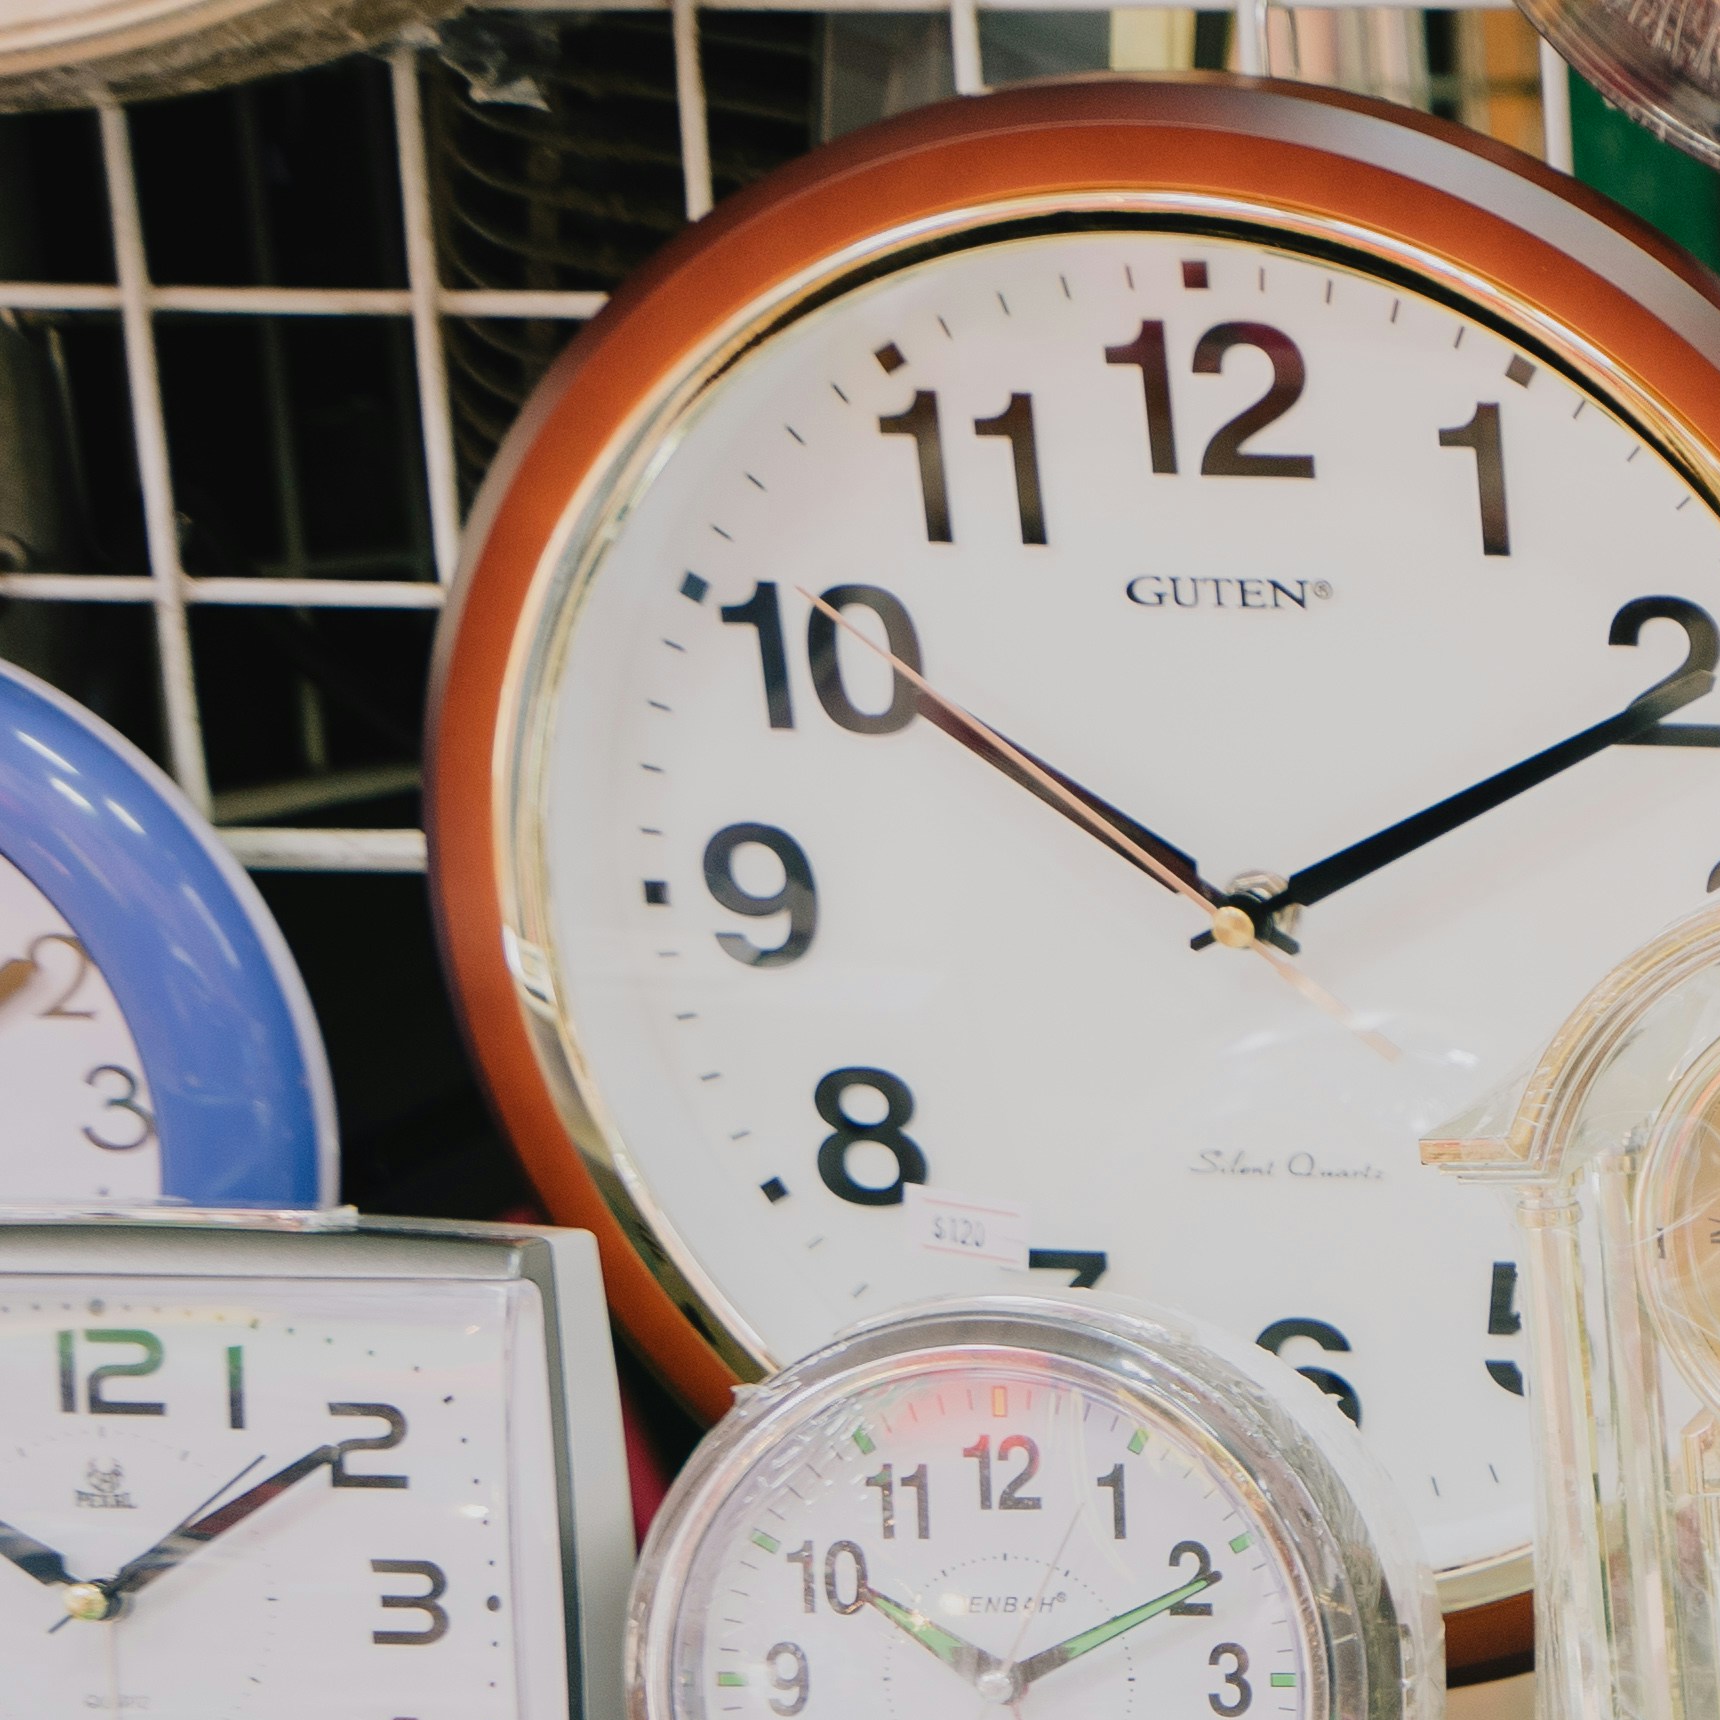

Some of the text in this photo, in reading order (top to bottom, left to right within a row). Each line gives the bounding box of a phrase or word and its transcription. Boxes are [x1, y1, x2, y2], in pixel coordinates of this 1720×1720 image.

[1104, 319, 1316, 479] 12
[878, 390, 1048, 546] 11
[1437, 402, 1513, 556] 1
[721, 580, 925, 734] 10
[702, 822, 817, 966] 9
[84, 1064, 155, 1151] 3
[814, 1067, 928, 1206] 8
[932, 1216, 985, 1249] $120
[57, 1329, 167, 1416] 12
[328, 1401, 409, 1489] 2
[962, 1434, 1042, 1510] 12
[866, 1464, 930, 1540] 11
[1097, 1464, 1127, 1540] 1
[371, 1559, 449, 1644] 3
[786, 1540, 870, 1616] 10
[1167, 1540, 1214, 1617] 2
[765, 1642, 810, 1717] 9
[1208, 1642, 1253, 1717] 3
